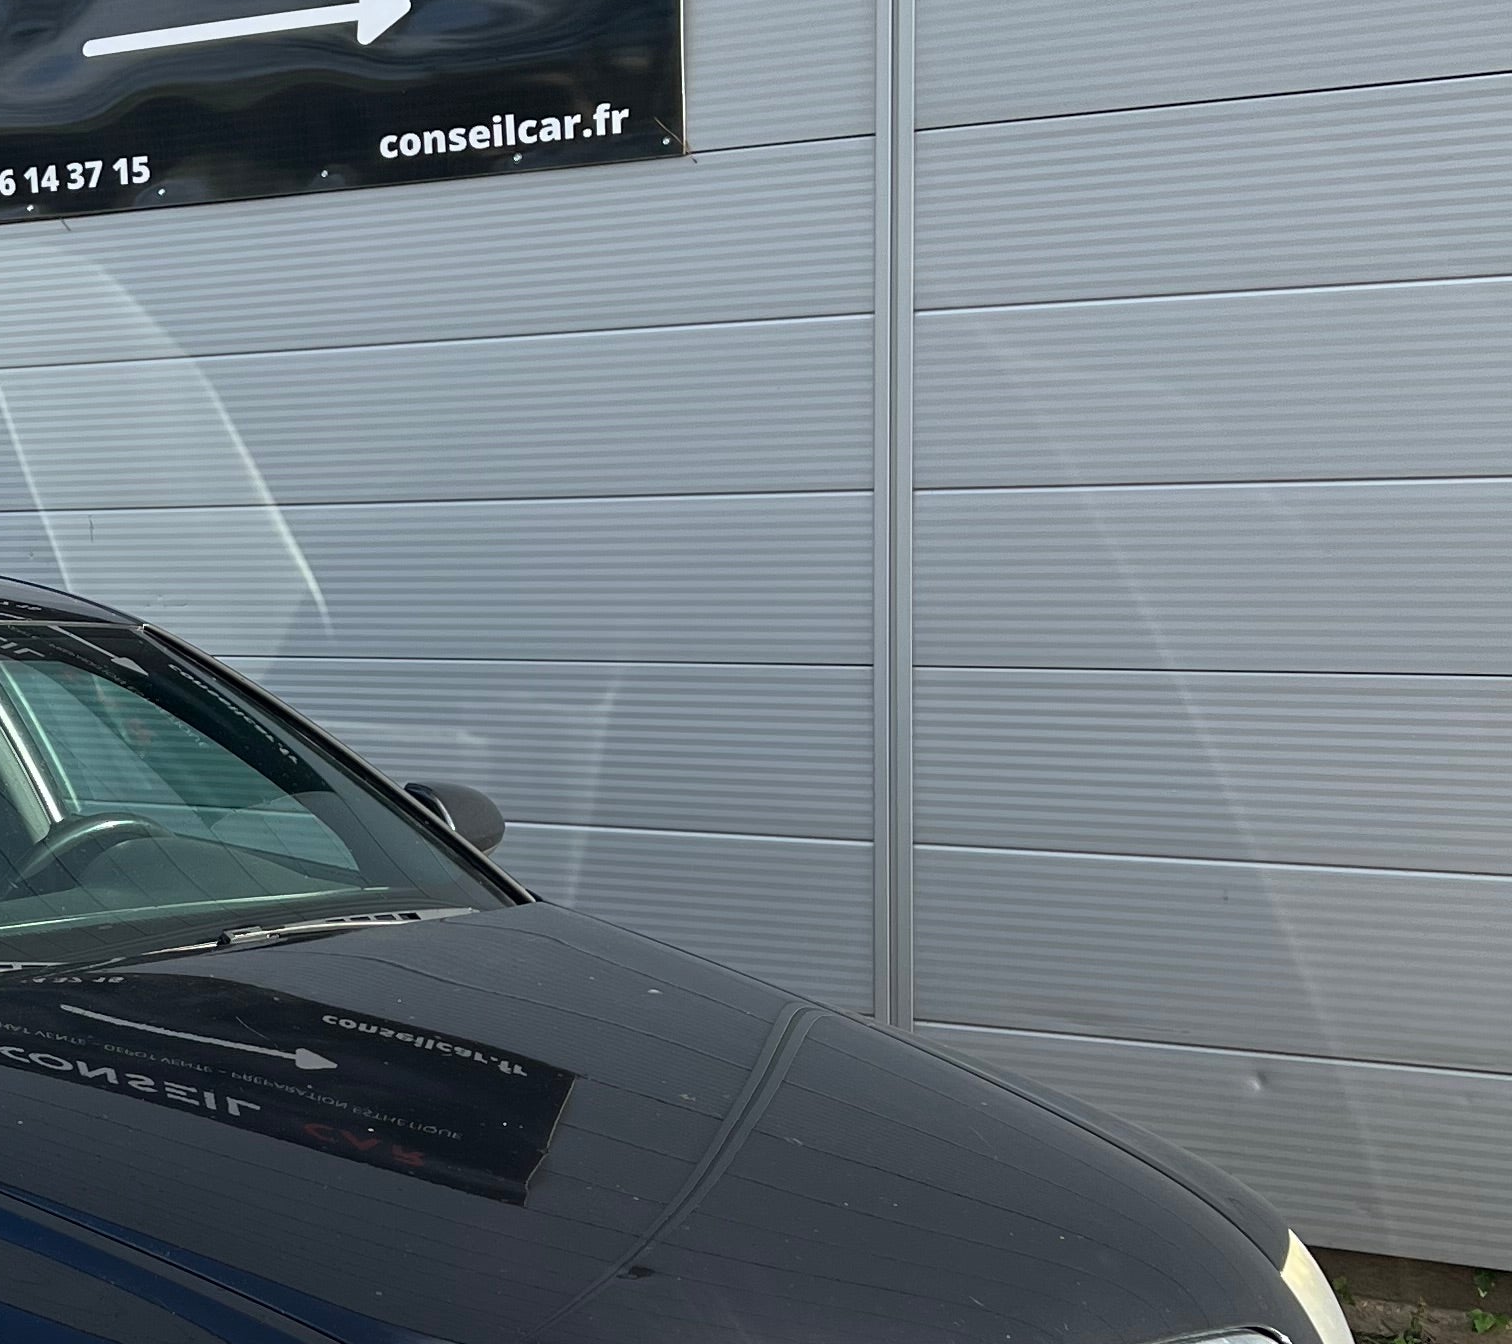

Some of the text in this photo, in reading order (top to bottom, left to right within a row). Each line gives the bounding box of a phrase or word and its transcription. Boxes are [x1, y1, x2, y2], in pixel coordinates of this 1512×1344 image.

[379, 102, 631, 159] conseilcar.fr
[23, 164, 60, 194] 14
[66, 159, 103, 190] 37
[112, 155, 151, 185] 15
